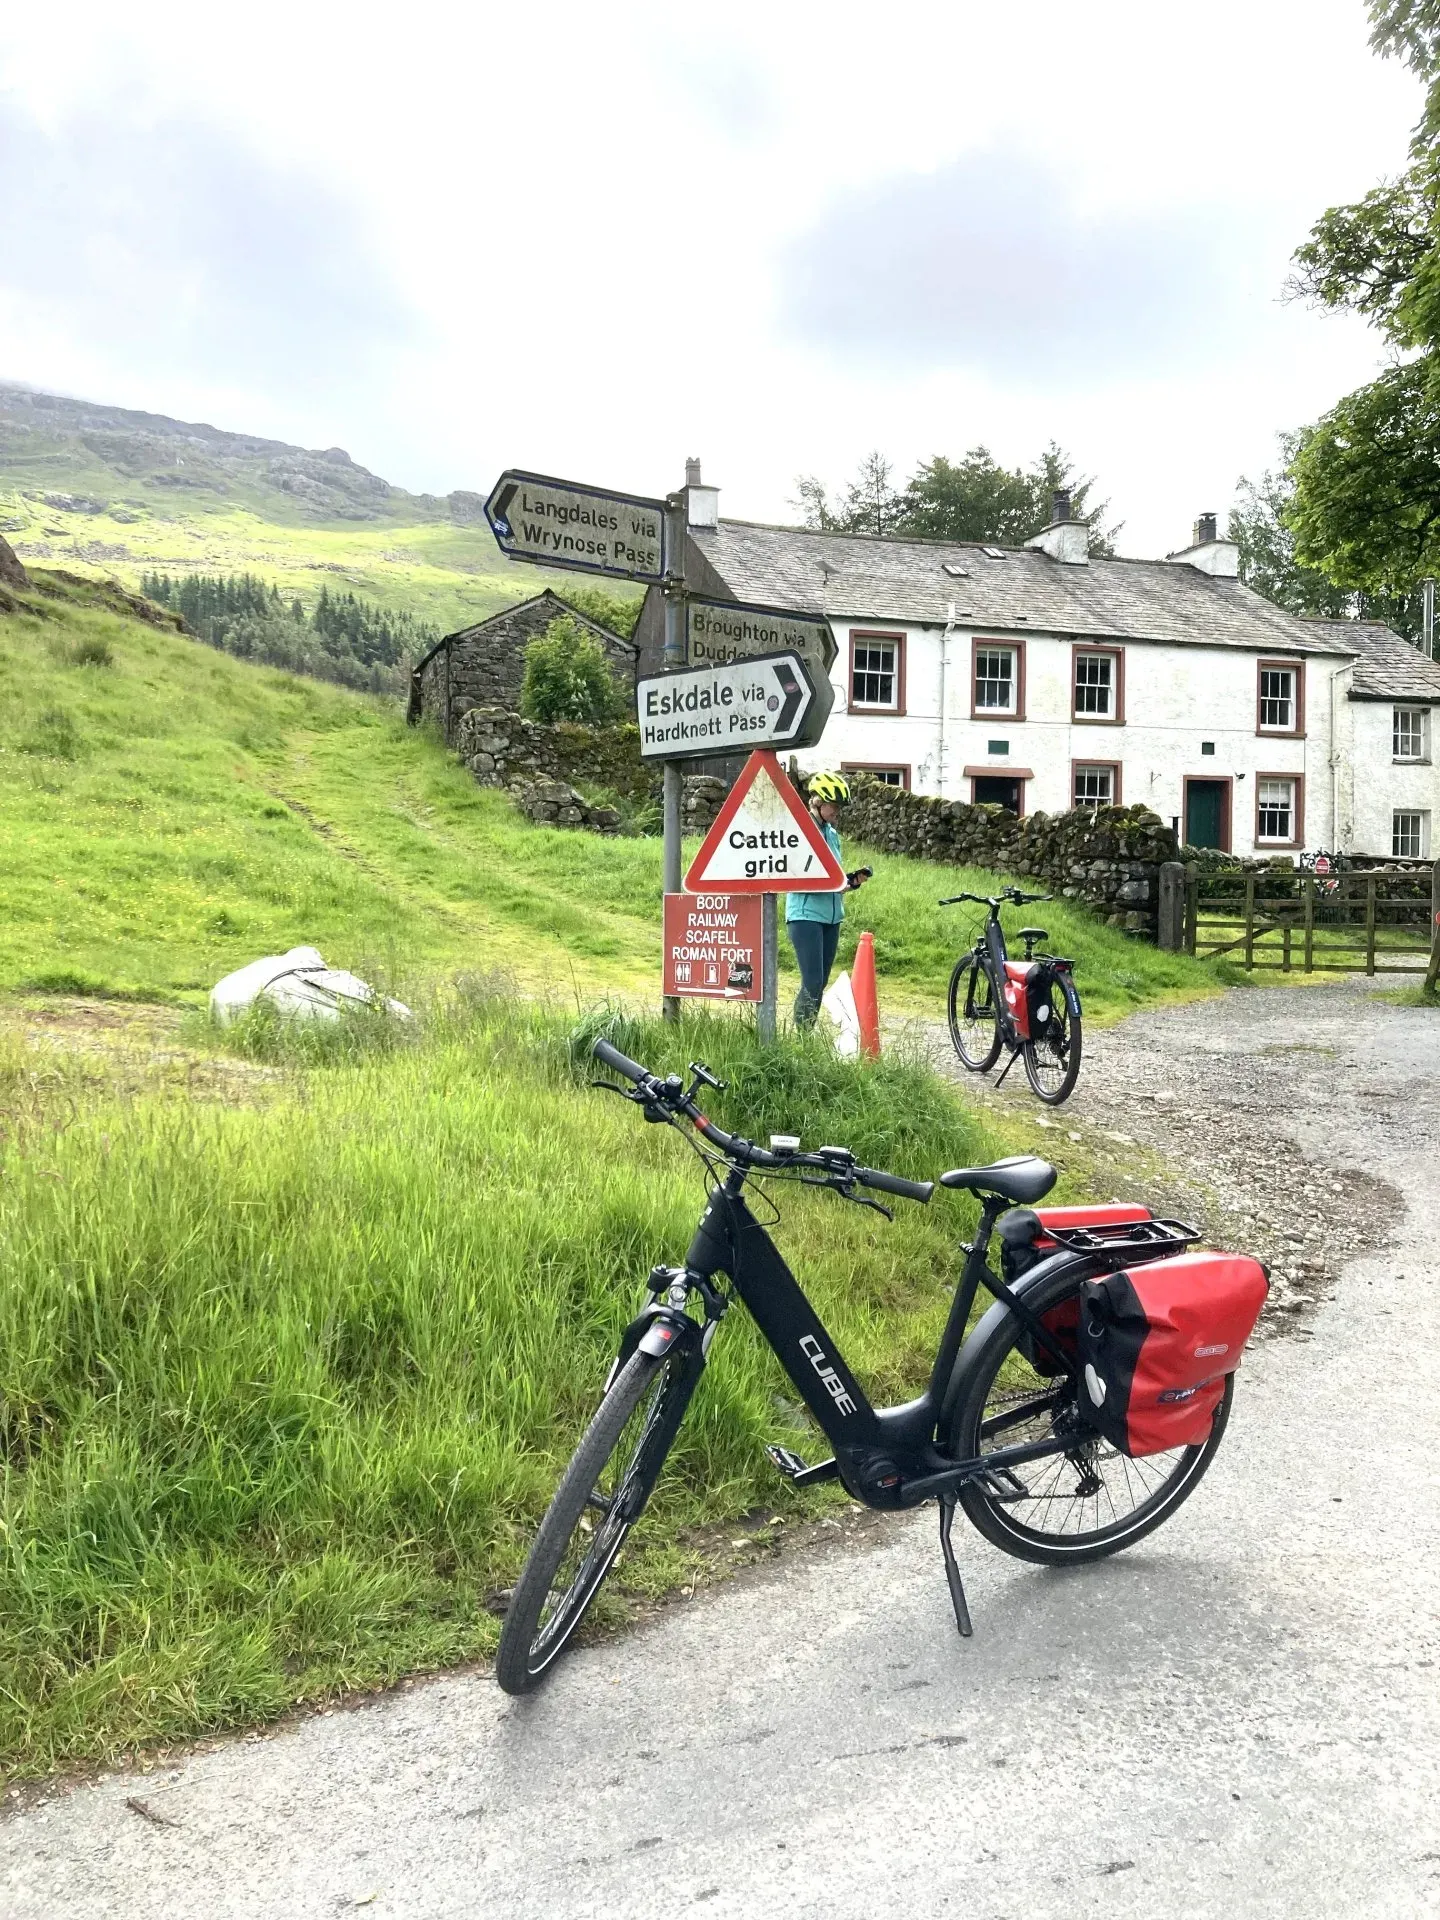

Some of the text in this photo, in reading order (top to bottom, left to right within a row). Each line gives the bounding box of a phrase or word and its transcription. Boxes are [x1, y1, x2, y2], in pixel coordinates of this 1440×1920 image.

[522, 493, 618, 530] Langdales
[630, 518, 656, 538] via
[523, 523, 606, 556] Wrynose
[614, 541, 655, 566] Pass
[693, 614, 806, 647] Broughton via
[646, 681, 765, 716] Eskdale via
[645, 714, 766, 743] Hardknott Pass
[729, 830, 799, 849] Cattle
[745, 855, 787, 877] grid
[697, 896, 730, 910] BOOT
[688, 913, 738, 927] RAILWAY
[686, 930, 739, 945] SCAFELL
[672, 947, 753, 962] ROMAN FORT
[798, 1335, 857, 1416] CUBE
